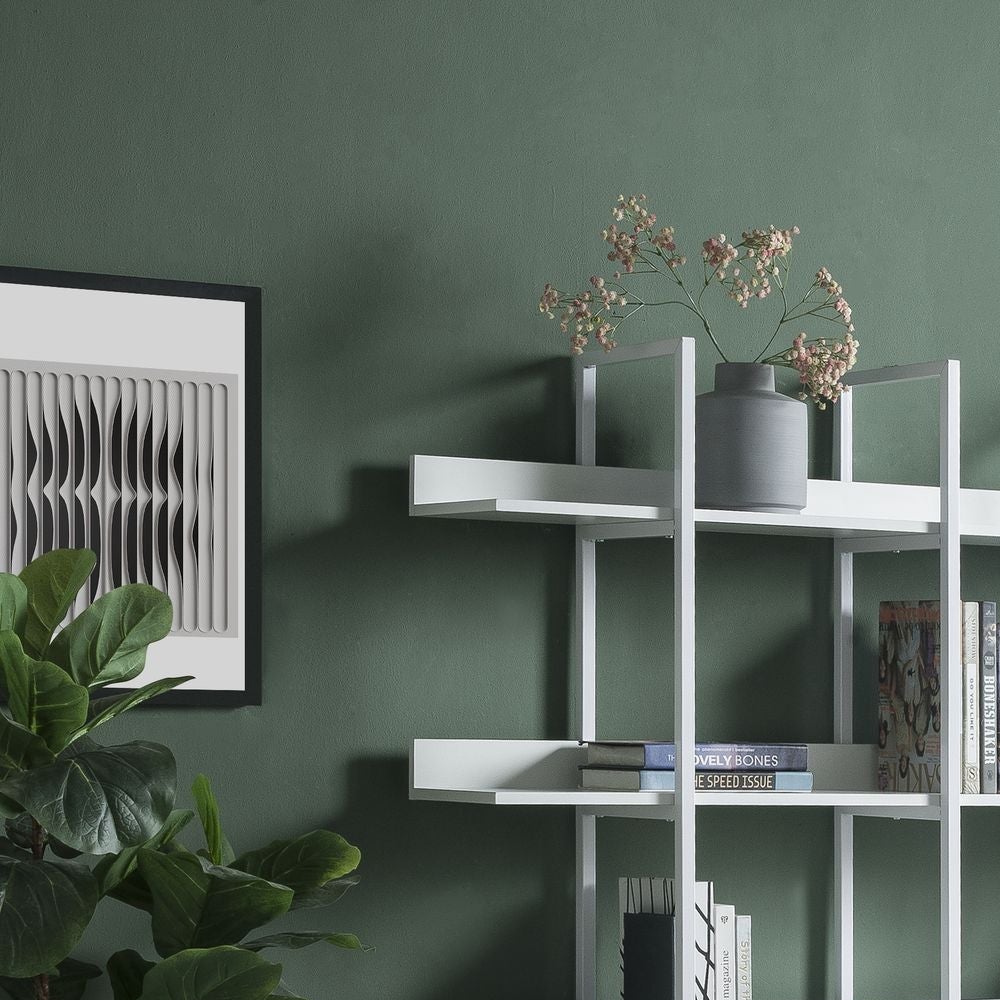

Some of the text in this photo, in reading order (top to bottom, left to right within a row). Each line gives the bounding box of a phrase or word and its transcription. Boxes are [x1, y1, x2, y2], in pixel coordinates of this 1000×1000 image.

[984, 675, 996, 765] BONESHAKER
[735, 754, 778, 766] BONES
[707, 775, 739, 788] SPEED
[741, 775, 773, 788] ISSUE
[740, 940, 750, 971] Story
[720, 950, 732, 999] magazine
[742, 974, 751, 989] of
